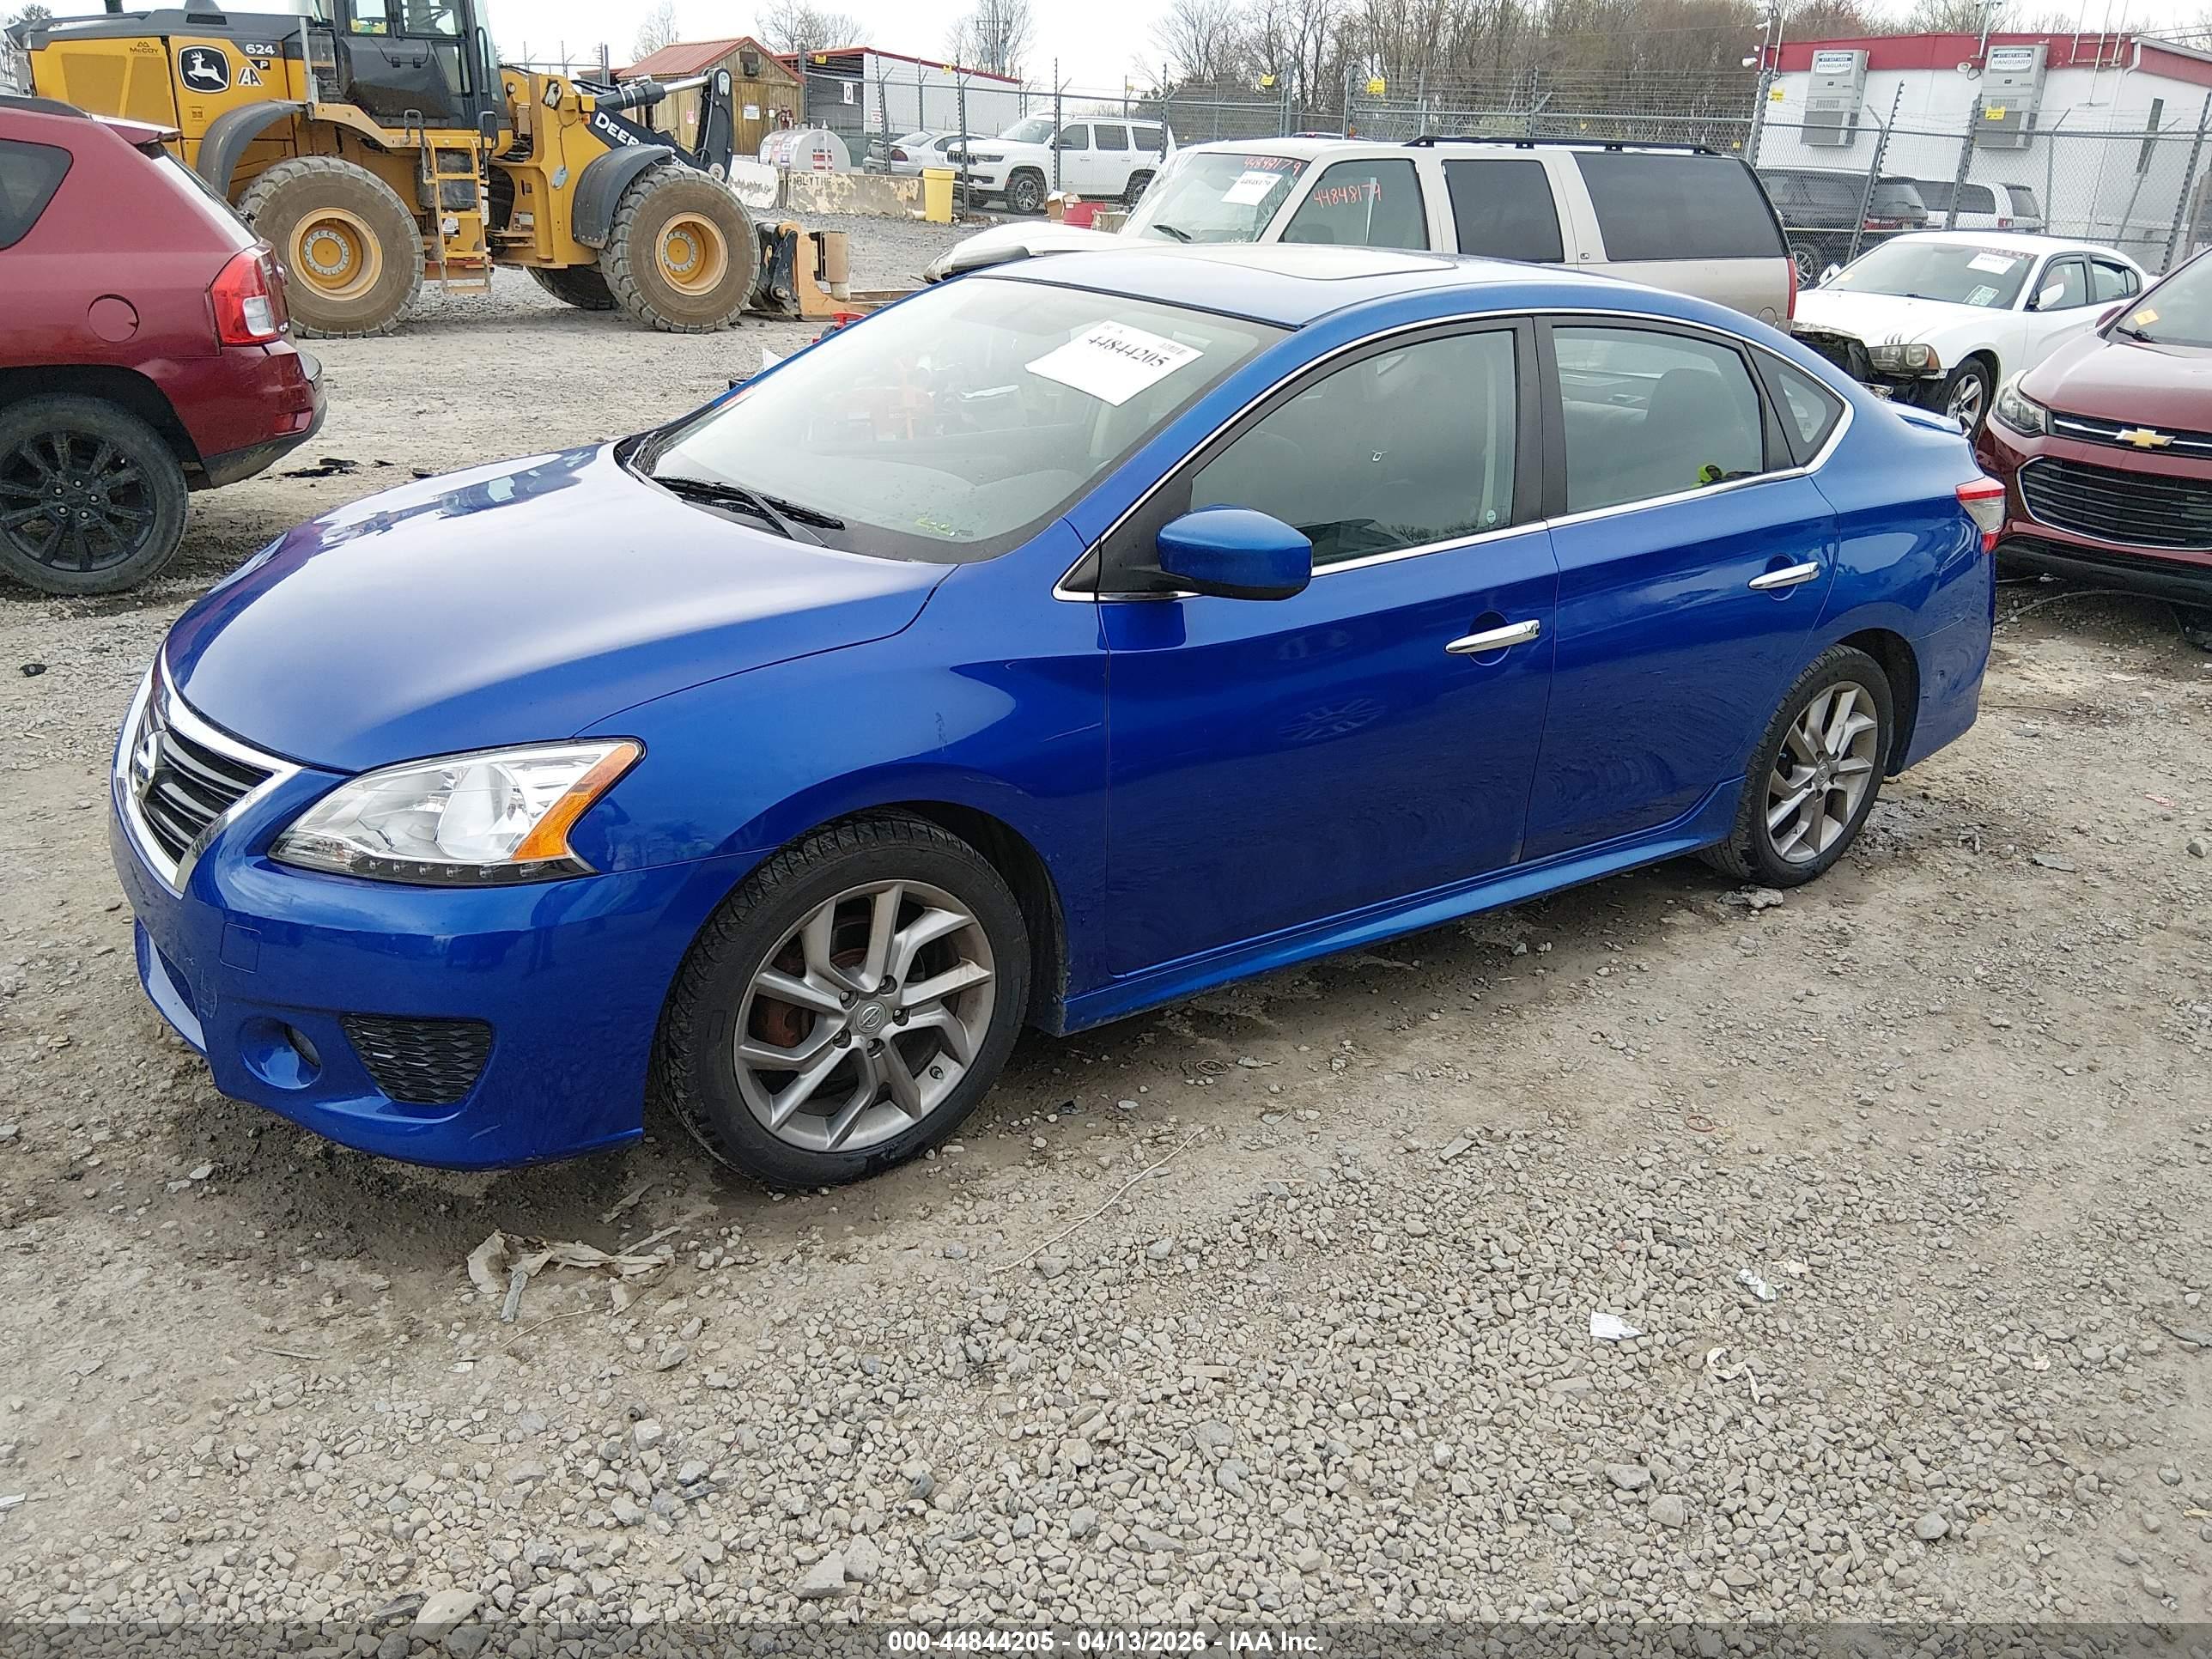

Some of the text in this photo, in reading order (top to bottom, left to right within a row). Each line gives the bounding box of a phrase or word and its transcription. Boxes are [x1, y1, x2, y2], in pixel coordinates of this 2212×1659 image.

[246, 45, 275, 55] 624
[260, 60, 268, 70] P
[846, 86, 852, 100] Q
[594, 112, 646, 147] DEER
[1244, 157, 1301, 176] 44848179
[1313, 183, 1382, 209] 44848179
[1088, 336, 1170, 367] 44844205
